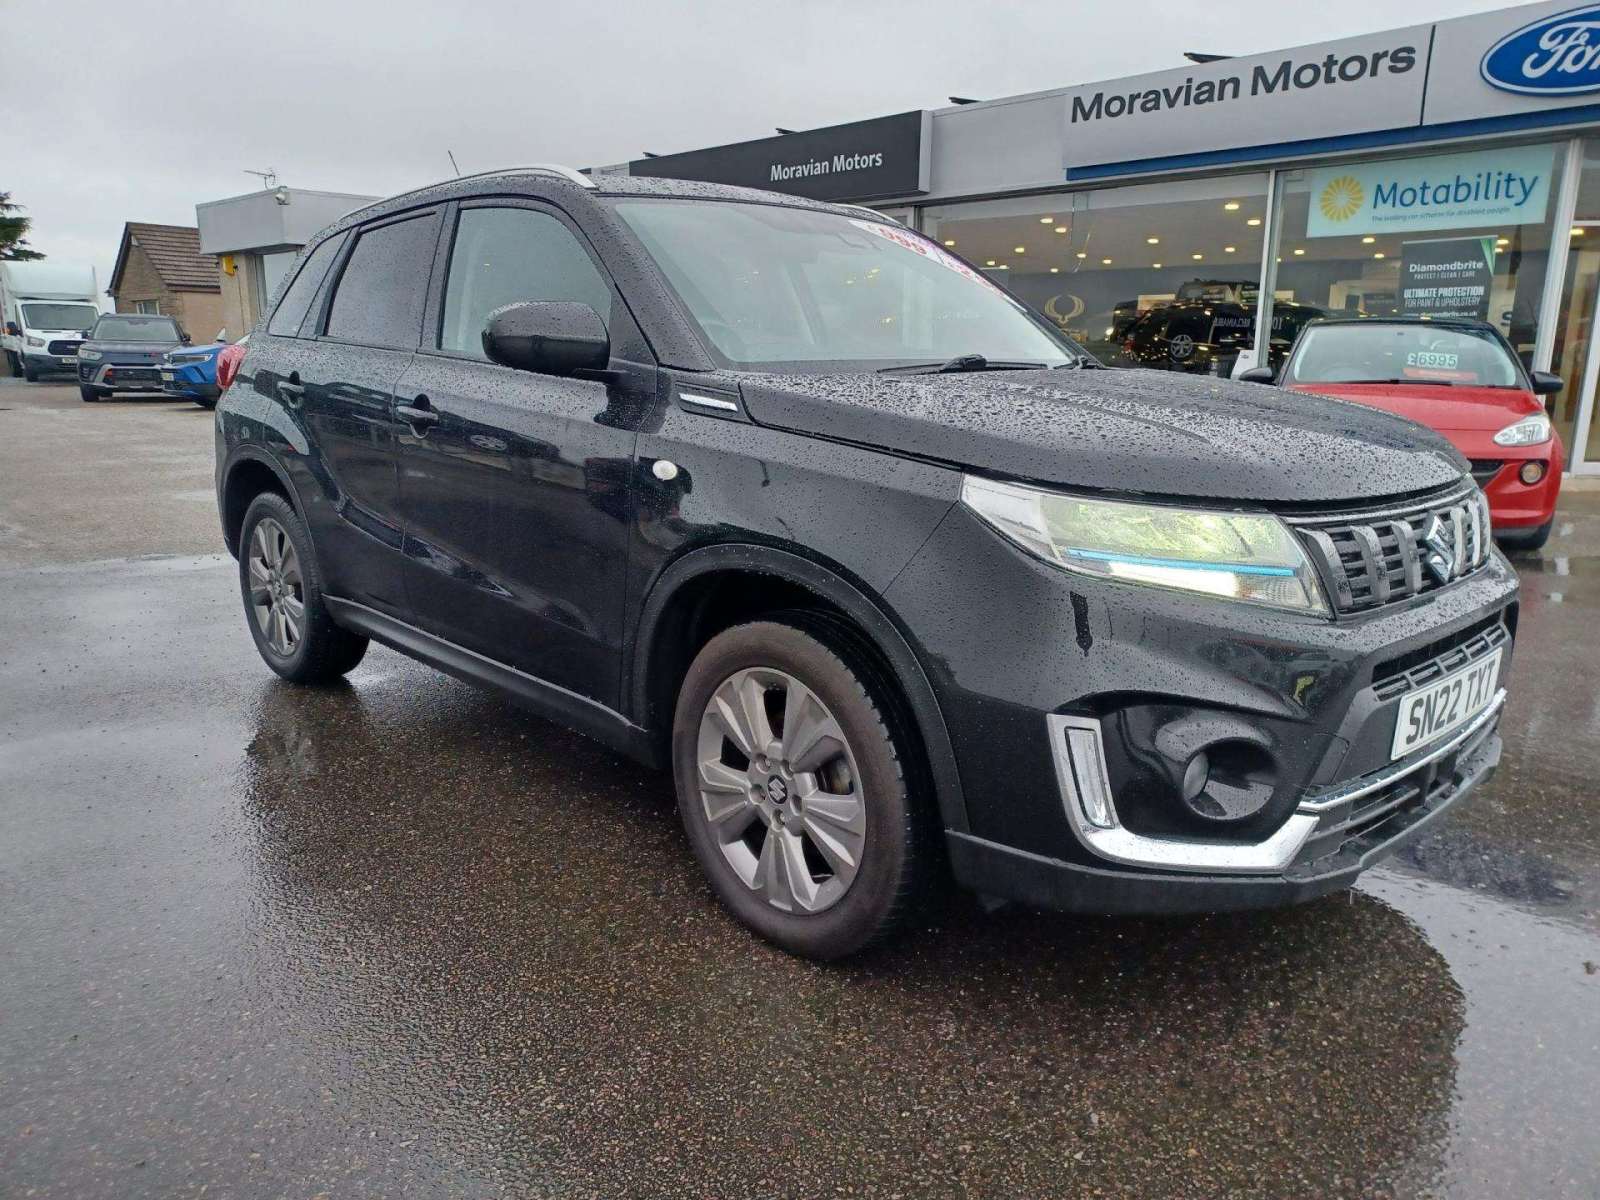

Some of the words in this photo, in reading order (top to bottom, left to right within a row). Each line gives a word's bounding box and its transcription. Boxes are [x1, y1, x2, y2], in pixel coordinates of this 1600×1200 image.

[1071, 77, 1241, 123] Moravian
[1251, 46, 1417, 96] Motors
[770, 159, 829, 181] Moravian
[832, 153, 882, 172] Motors
[1373, 171, 1539, 207] Motability
[1409, 261, 1484, 273] Diamondbrite
[1404, 287, 1438, 299] ULTIMATE
[1438, 286, 1485, 298] PROTECTION
[1407, 352, 1457, 368] £6995
[1406, 679, 1463, 745] SN22
[1465, 659, 1496, 712] TXT
